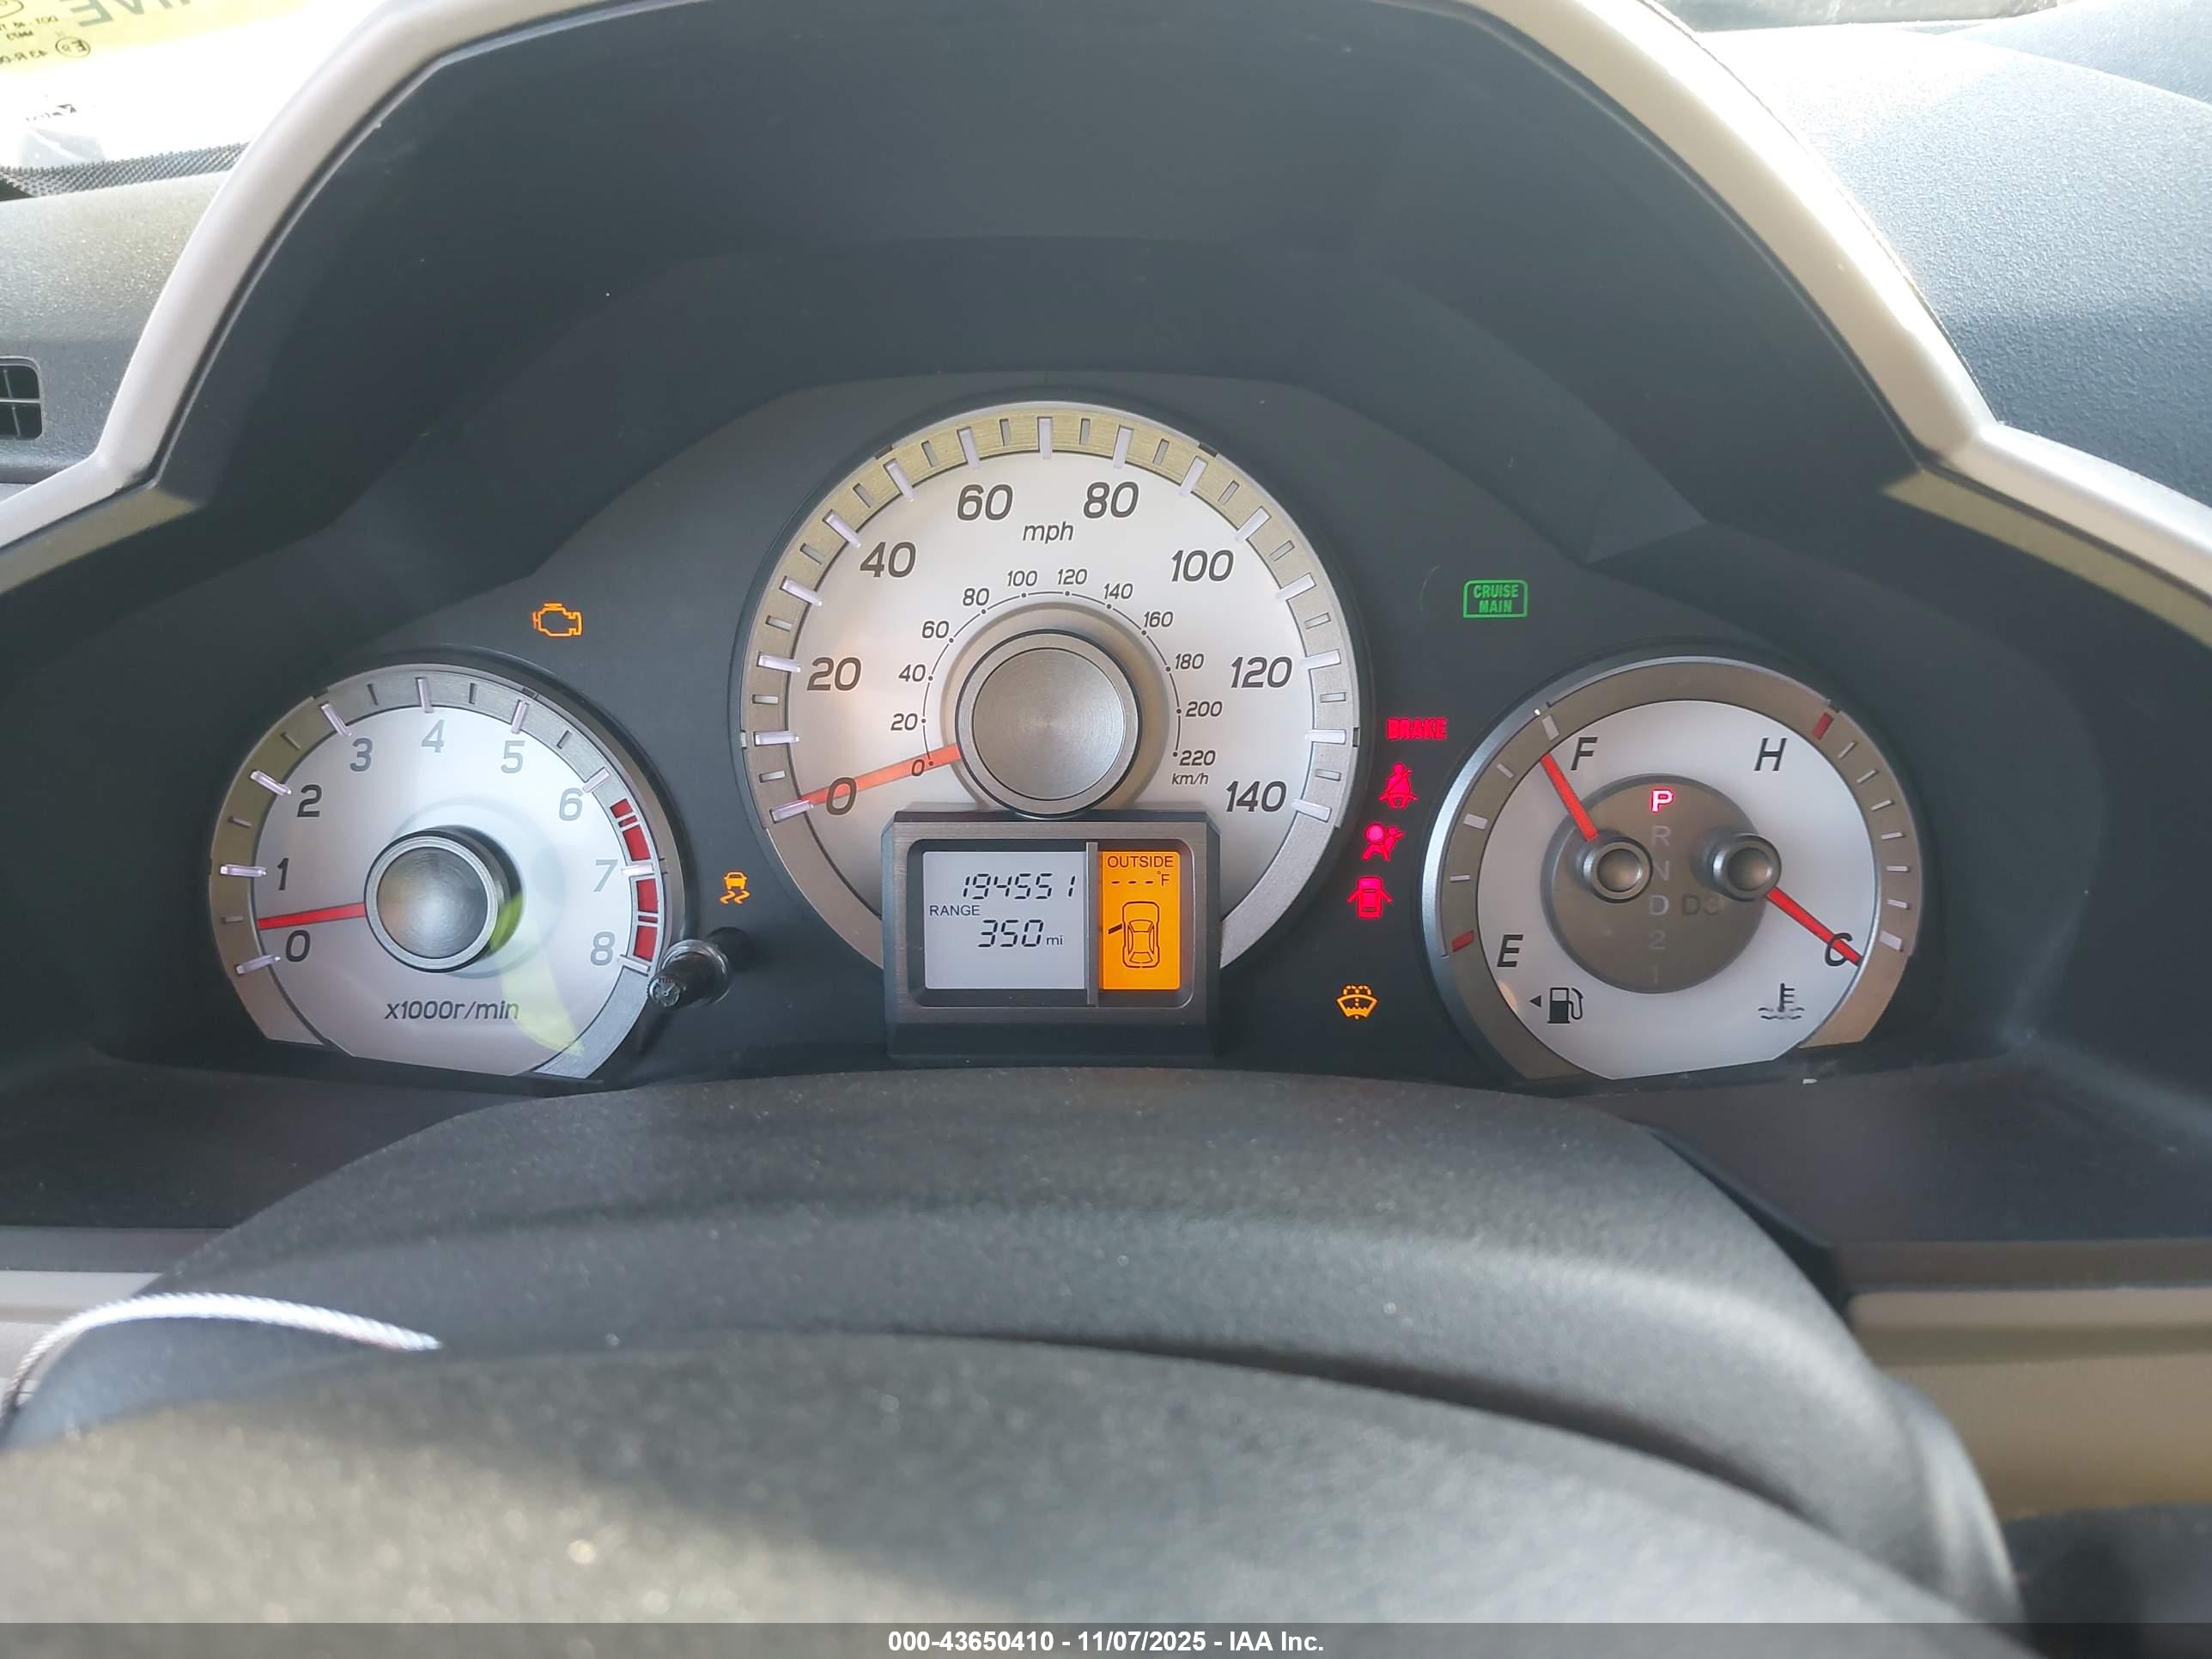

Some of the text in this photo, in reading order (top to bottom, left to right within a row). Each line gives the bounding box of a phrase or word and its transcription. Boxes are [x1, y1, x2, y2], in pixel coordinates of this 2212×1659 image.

[958, 485, 1013, 521] 60
[1085, 483, 1139, 520] 80
[1024, 522, 1074, 544] mph
[861, 543, 916, 578] 40
[1173, 551, 1234, 582] 100
[1009, 572, 1038, 587] 100
[1060, 570, 1088, 586] 120
[964, 589, 990, 606] 80
[1105, 585, 1133, 600] 140
[1474, 584, 1519, 599] CRUISE
[1479, 599, 1512, 614] MAIN
[923, 622, 950, 639] 60
[1146, 612, 1174, 628] 160
[807, 658, 861, 691] 20
[900, 665, 927, 683] 40
[1176, 654, 1205, 670] 180
[1232, 658, 1292, 689] 120
[891, 714, 918, 732] 20
[1187, 702, 1223, 718] 200
[421, 718, 445, 754] 4
[1388, 718, 1448, 742] BRAKE
[349, 737, 374, 773] 3
[501, 740, 526, 775] 5
[1181, 751, 1216, 767] 220
[1571, 736, 1599, 772] F
[1755, 738, 1788, 772] H
[909, 757, 925, 778] 0
[1173, 775, 1209, 785] km/h
[297, 784, 323, 819] 2
[559, 787, 584, 822] 6
[825, 776, 855, 816] 0
[1228, 782, 1287, 812] 140
[1651, 792, 1673, 812] P
[1650, 825, 1672, 846] R
[1107, 854, 1175, 869] OUTSIDE
[277, 857, 290, 893] 1
[592, 860, 620, 894] 7
[963, 872, 1077, 901] 194551
[931, 906, 981, 916] RANGE
[1649, 895, 1669, 915] D
[285, 929, 311, 963] 0
[977, 917, 1066, 949] 350 mi
[591, 933, 617, 967] 8
[1498, 935, 1524, 968] E
[1824, 932, 1854, 967] C
[384, 1000, 520, 1021] x1000r/min
